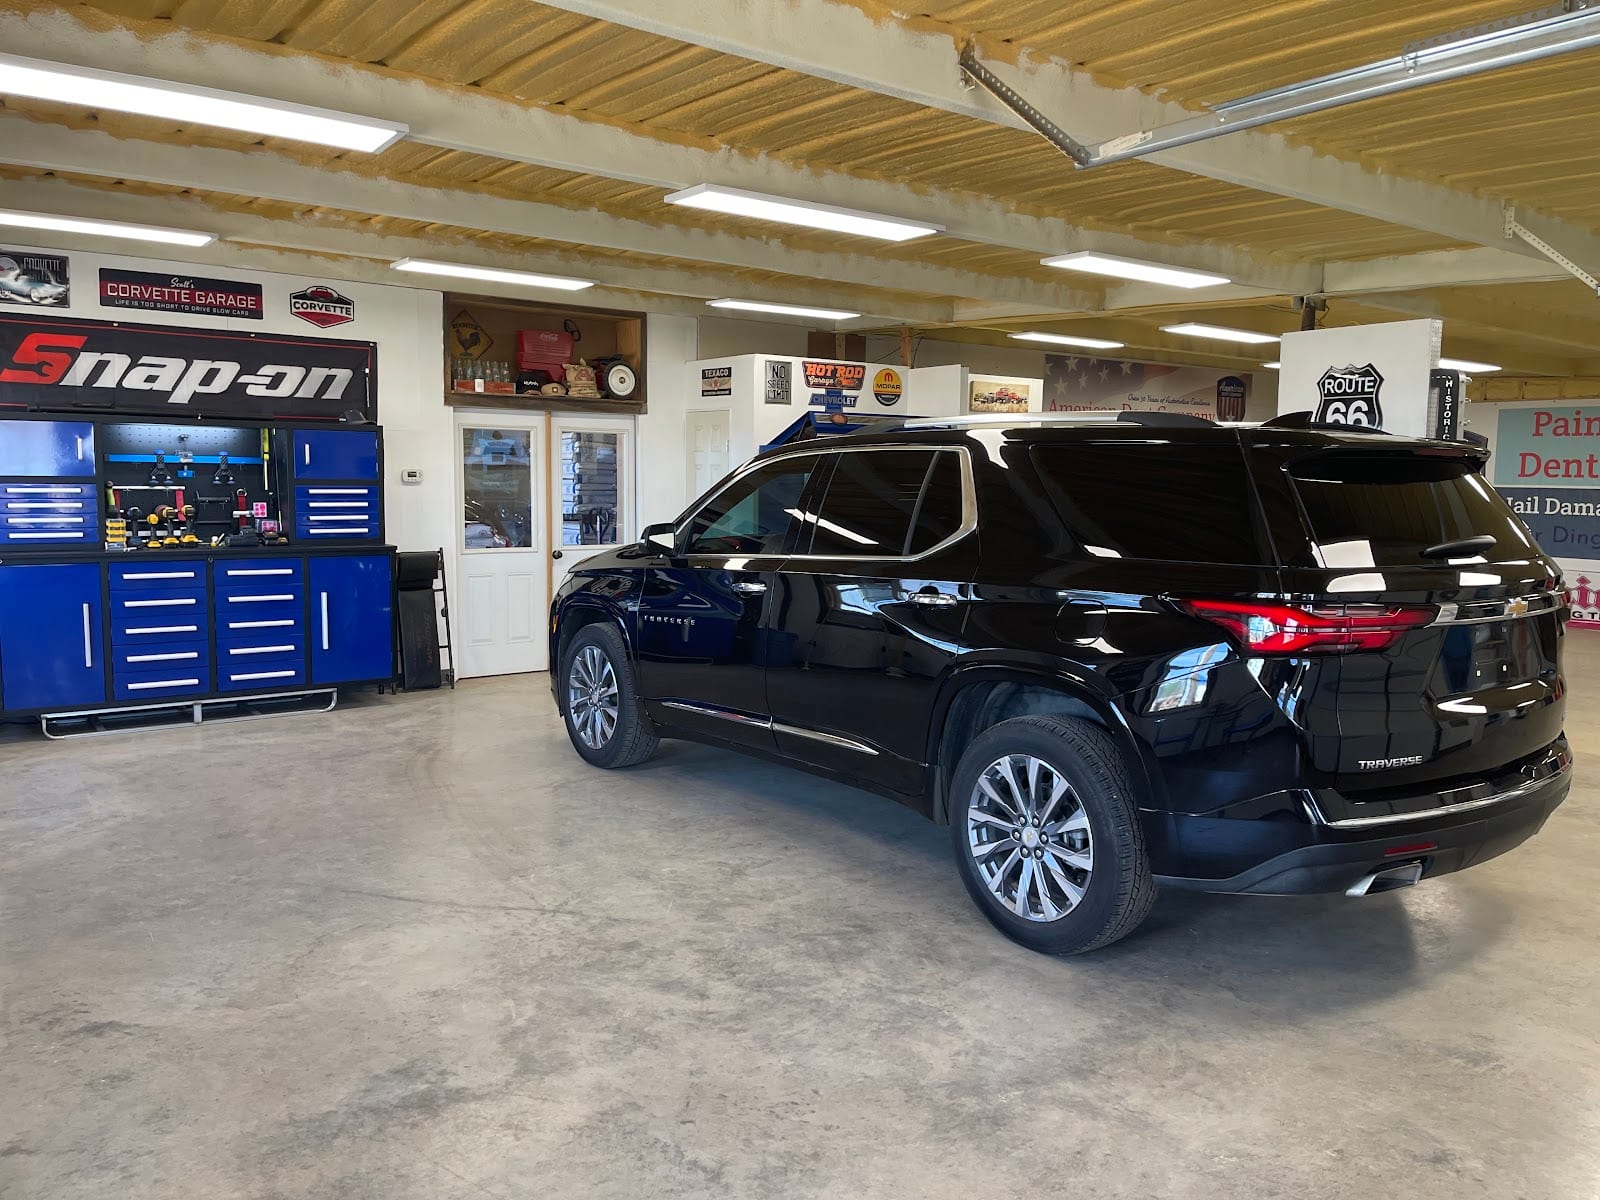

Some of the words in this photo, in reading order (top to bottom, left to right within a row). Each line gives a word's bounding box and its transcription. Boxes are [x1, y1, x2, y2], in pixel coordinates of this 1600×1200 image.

[170, 277, 194, 289] Scott's
[107, 283, 190, 302] CORVETTE
[196, 292, 257, 308] GARAGE
[156, 302, 178, 310] SHORT
[293, 301, 352, 316] CORVETTE
[0, 332, 354, 404] Snap-on
[704, 368, 729, 377] TEXACO
[772, 365, 785, 378] NO
[805, 363, 835, 376] HOT
[836, 366, 864, 378] ROD
[767, 380, 789, 390] SPEED
[808, 376, 834, 385] Garage
[1324, 377, 1375, 394] ROUTE
[767, 390, 789, 400] LIMIT
[813, 396, 855, 405] CHEVROLET
[1326, 400, 1368, 425] 66
[1442, 380, 1453, 440] HISTORIC
[1518, 452, 1598, 478] Dent
[1553, 526, 1600, 549] Ding
[644, 615, 696, 626] TRAVERSE
[1358, 755, 1423, 770] TRAVERSE
